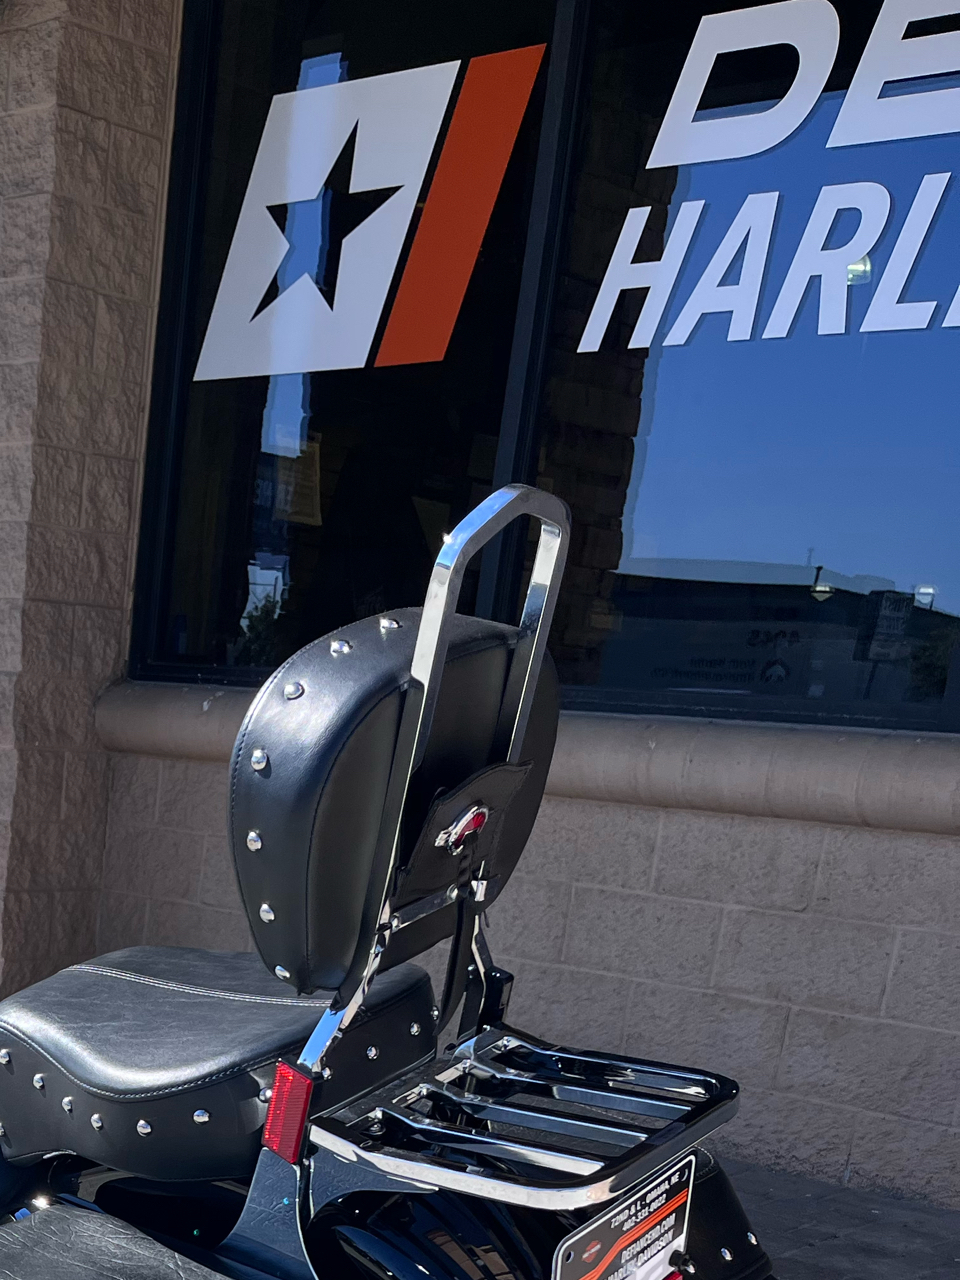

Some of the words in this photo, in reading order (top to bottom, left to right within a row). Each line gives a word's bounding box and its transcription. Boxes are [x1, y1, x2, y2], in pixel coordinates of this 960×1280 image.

[645, 0, 960, 169] DE
[577, 171, 960, 353] HARL
[610, 1209, 629, 1229] 72ND
[629, 1204, 636, 1216] &
[670, 1171, 680, 1187] NE
